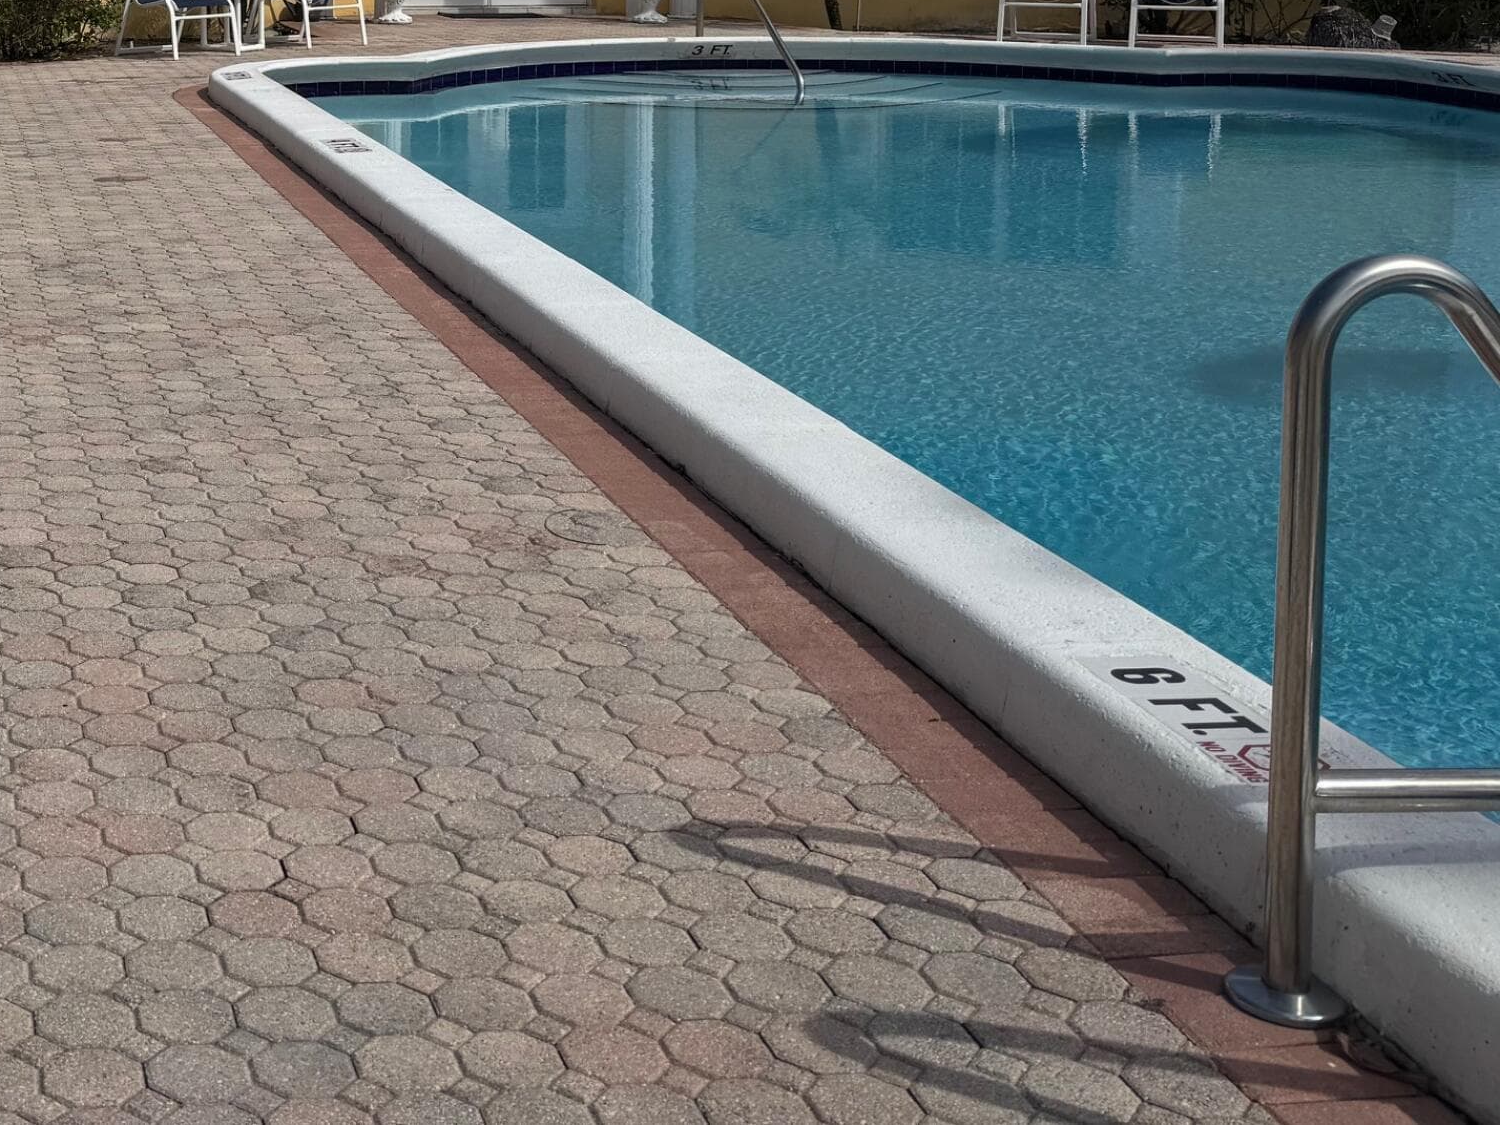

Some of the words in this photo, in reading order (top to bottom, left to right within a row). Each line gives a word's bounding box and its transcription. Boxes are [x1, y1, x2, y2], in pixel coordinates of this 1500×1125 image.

[692, 44, 704, 56] 3
[710, 44, 733, 55] FT.
[1110, 667, 1186, 684] 6
[1147, 697, 1268, 735] FT.
[1196, 741, 1226, 752] NO
[1215, 755, 1269, 783] DIVING
